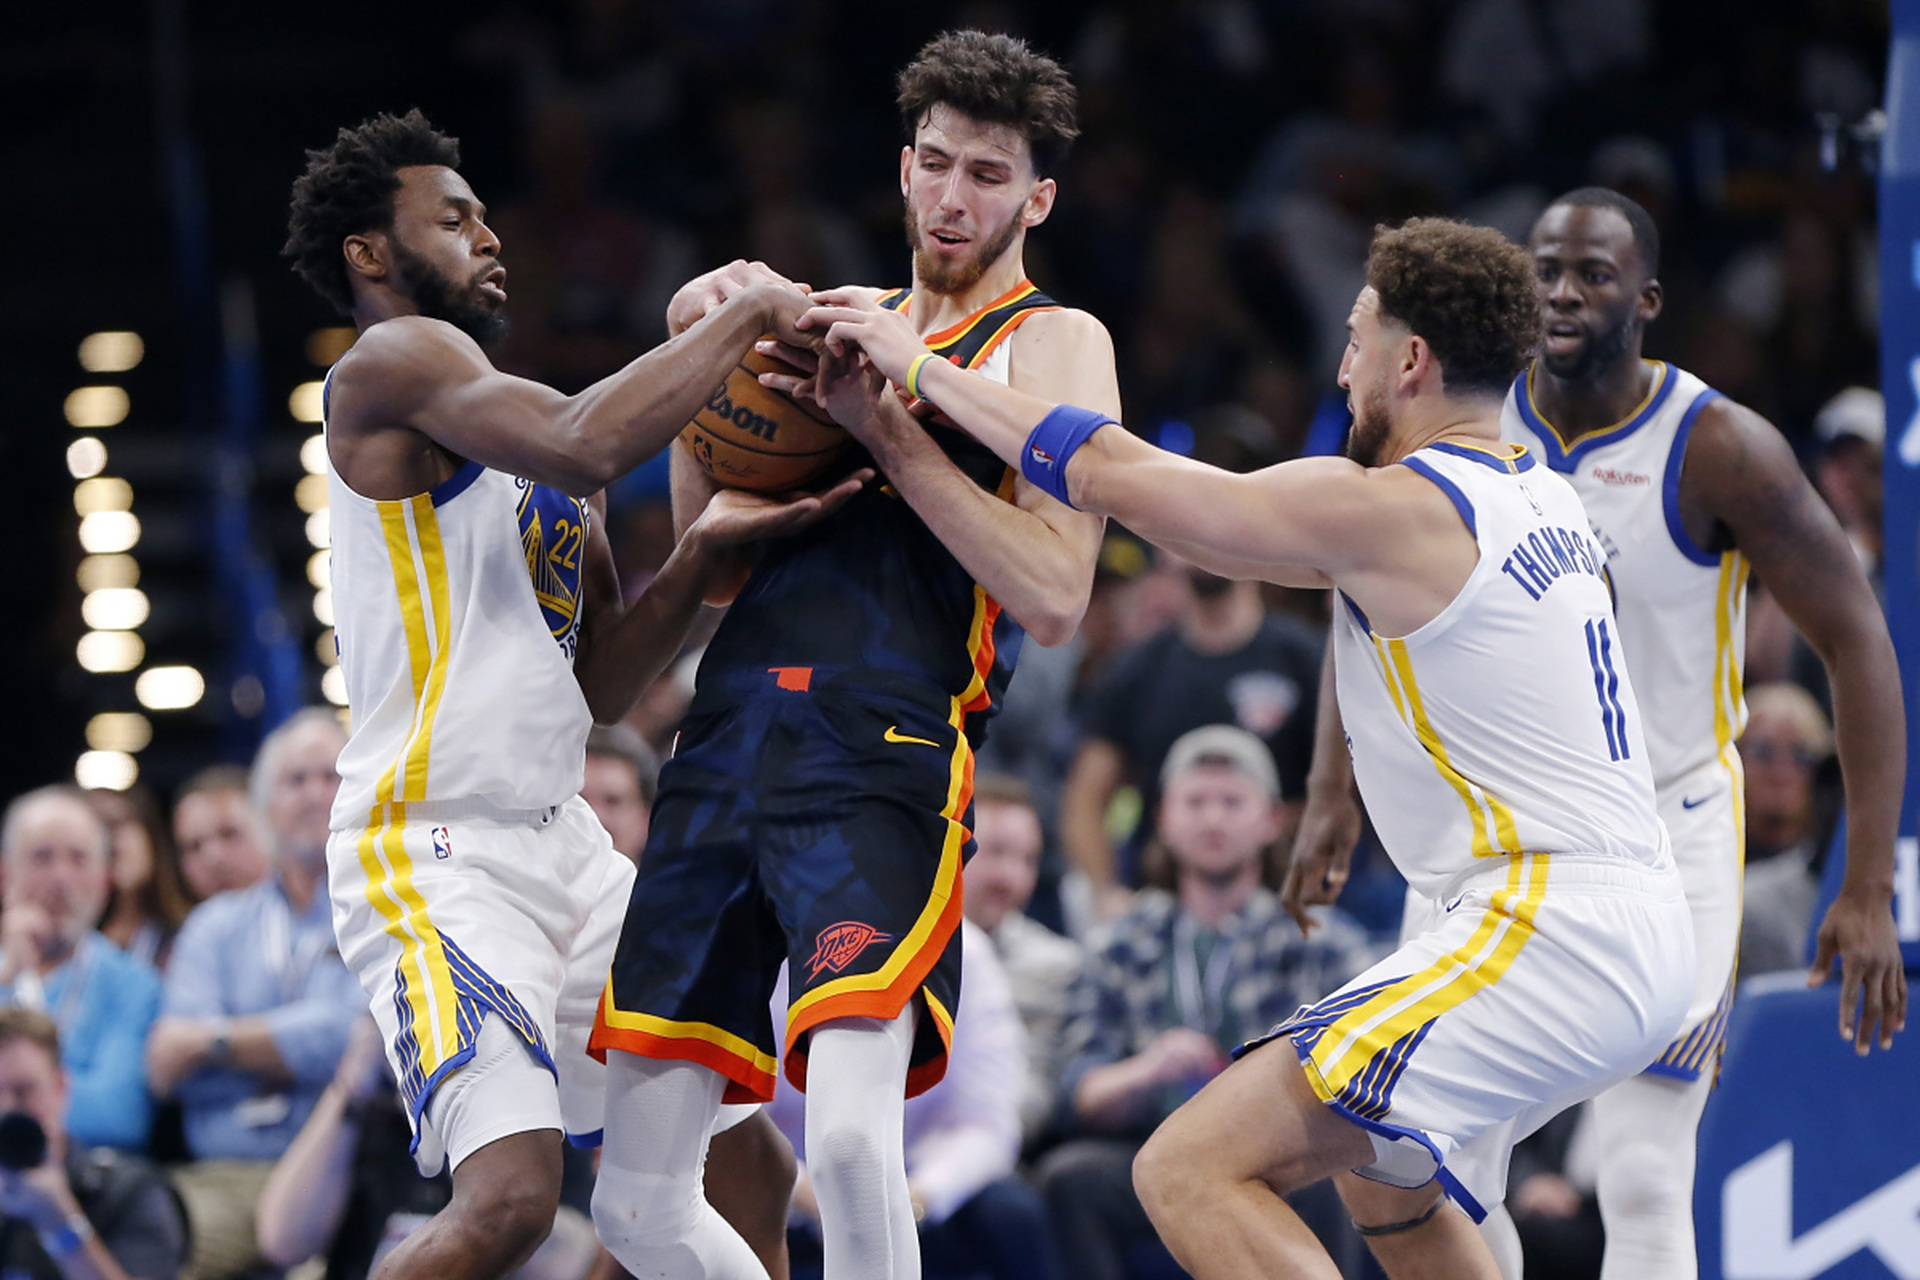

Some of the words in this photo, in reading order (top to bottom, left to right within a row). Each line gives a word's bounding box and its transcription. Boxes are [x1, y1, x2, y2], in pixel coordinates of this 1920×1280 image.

[705, 381, 778, 442] lson
[1593, 466, 1651, 486] Rakuten
[549, 518, 582, 570] 22
[1584, 618, 1631, 762] 11
